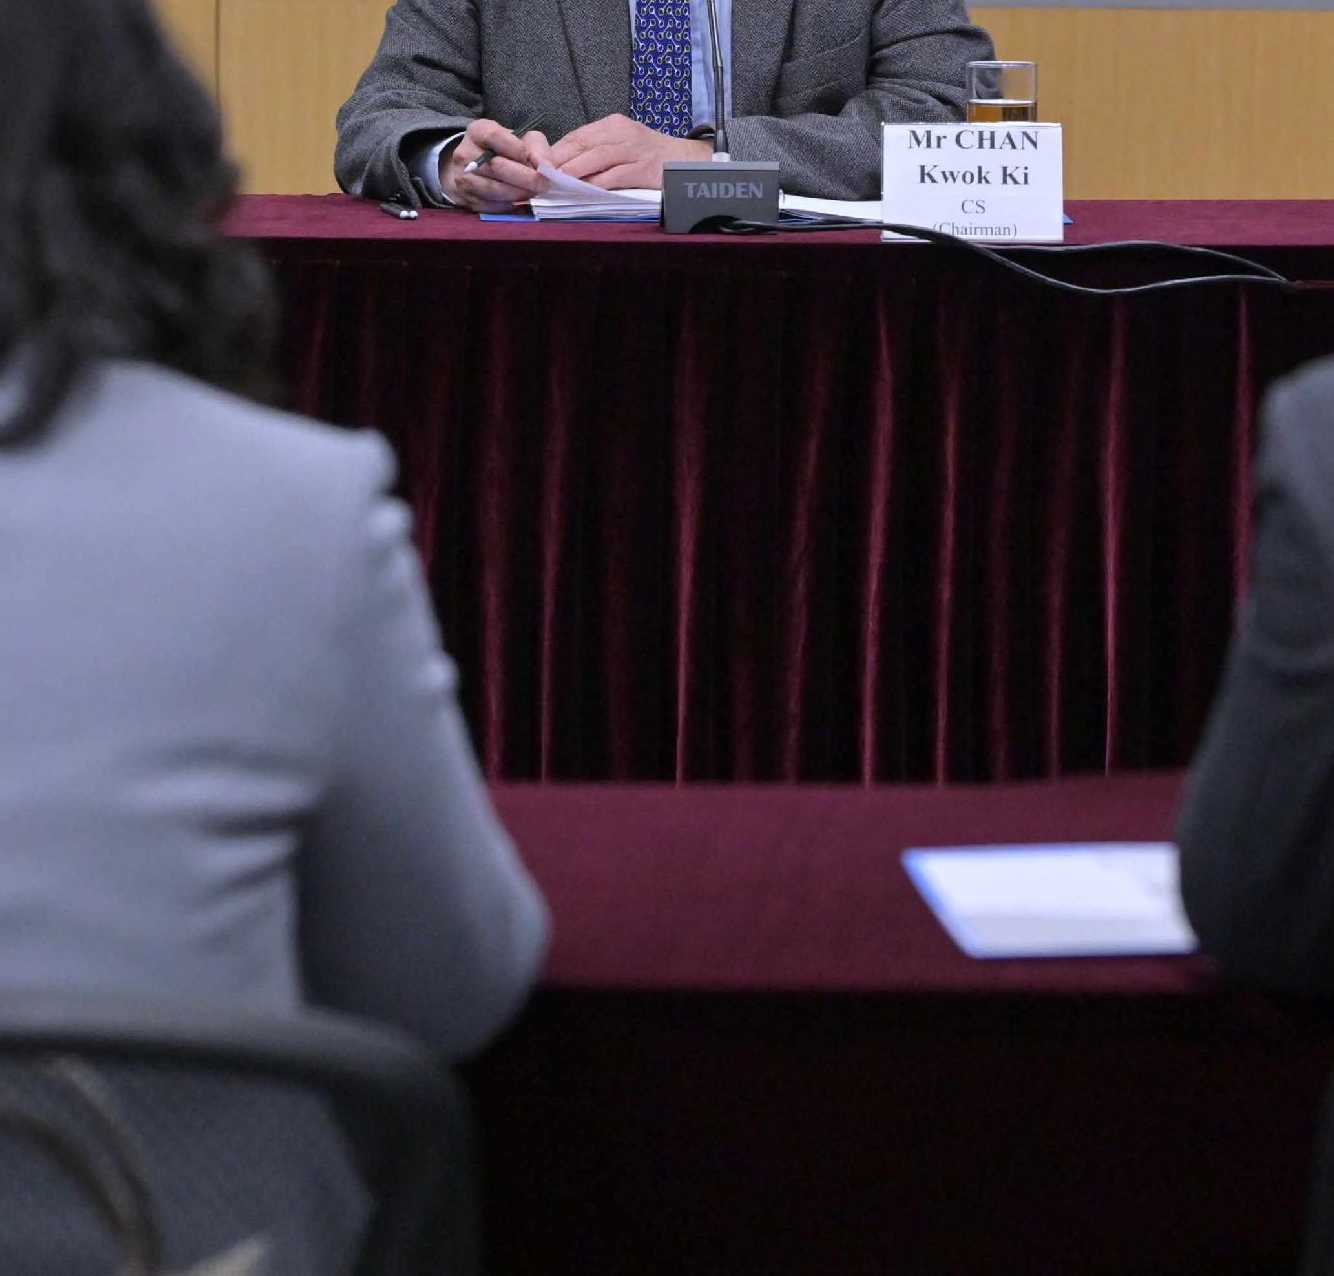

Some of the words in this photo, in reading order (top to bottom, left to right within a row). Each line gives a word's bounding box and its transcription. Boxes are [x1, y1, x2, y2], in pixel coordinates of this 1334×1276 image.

[908, 130, 947, 149] Mr
[955, 129, 1039, 150] CHAN
[918, 164, 992, 185] Kwok
[1001, 165, 1029, 186] Ki
[683, 182, 764, 199] TAIDEN
[961, 199, 986, 215] CS
